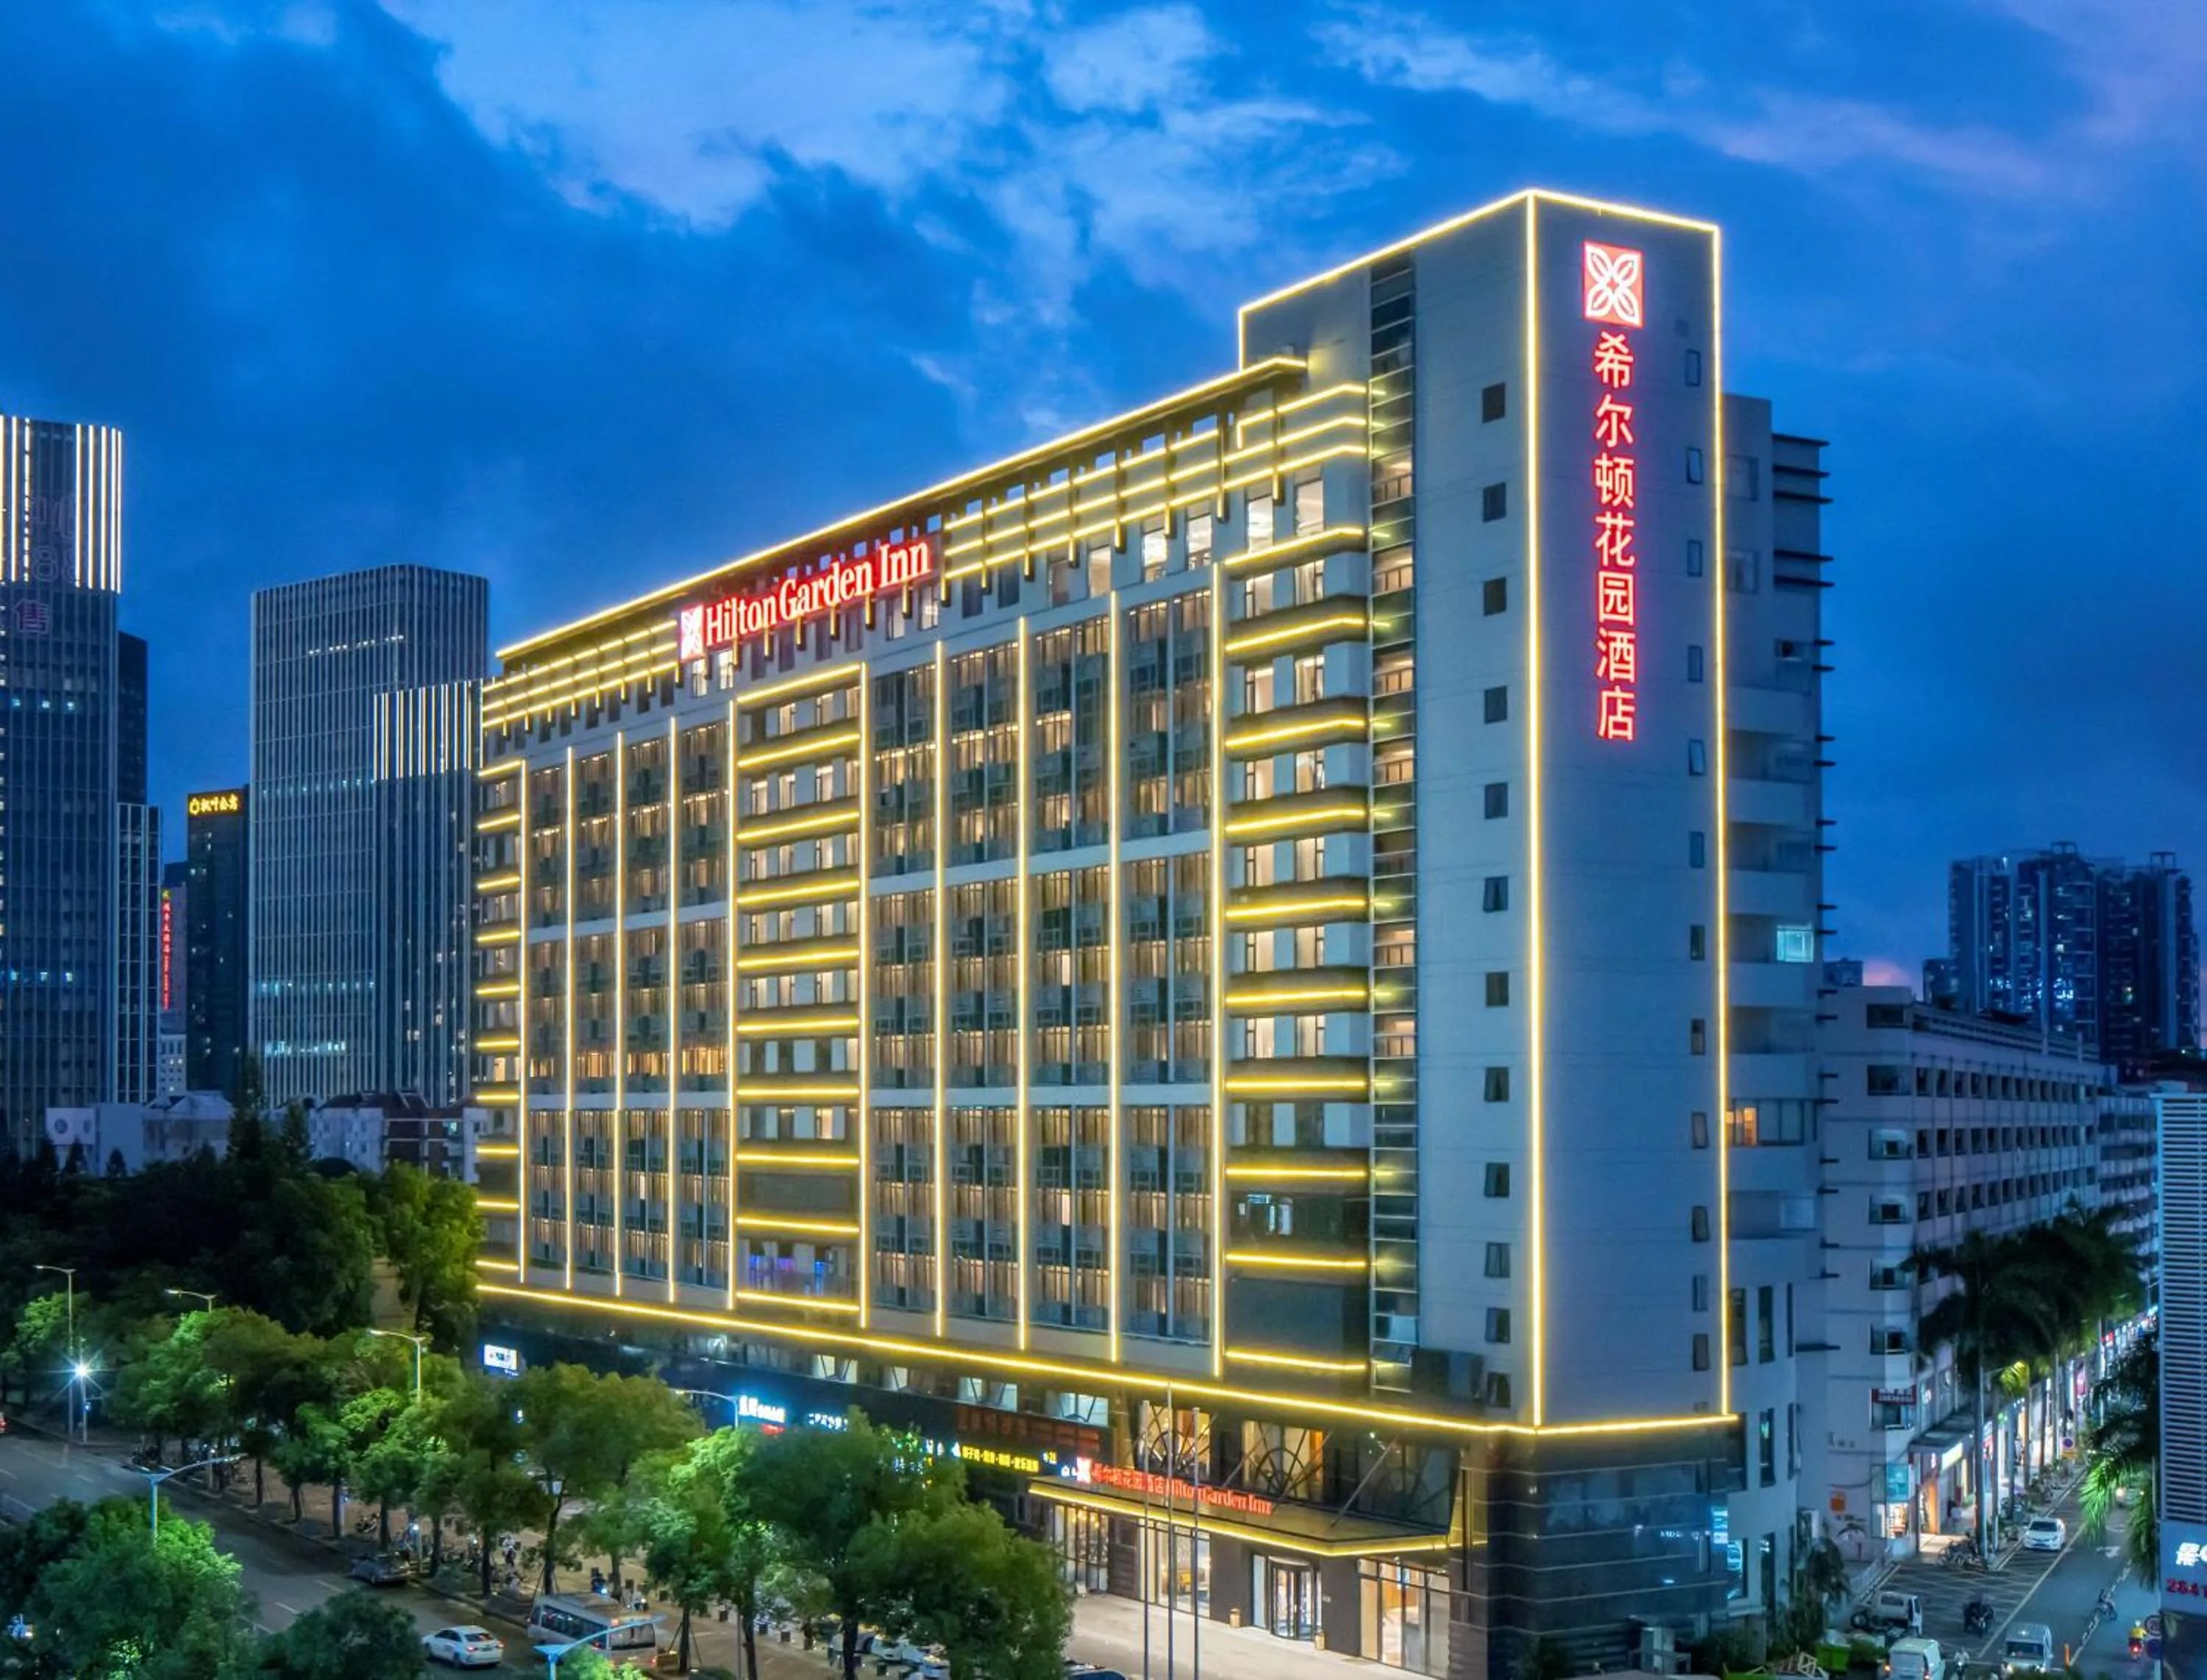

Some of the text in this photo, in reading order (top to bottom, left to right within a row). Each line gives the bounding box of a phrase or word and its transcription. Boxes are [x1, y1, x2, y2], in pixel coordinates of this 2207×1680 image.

[1593, 330, 1637, 741] 希尔顿花园酒店
[706, 541, 931, 647] Hilton Garden Inn
[1202, 1485, 1246, 1510] Garden
[1248, 1494, 1273, 1516] Inn
